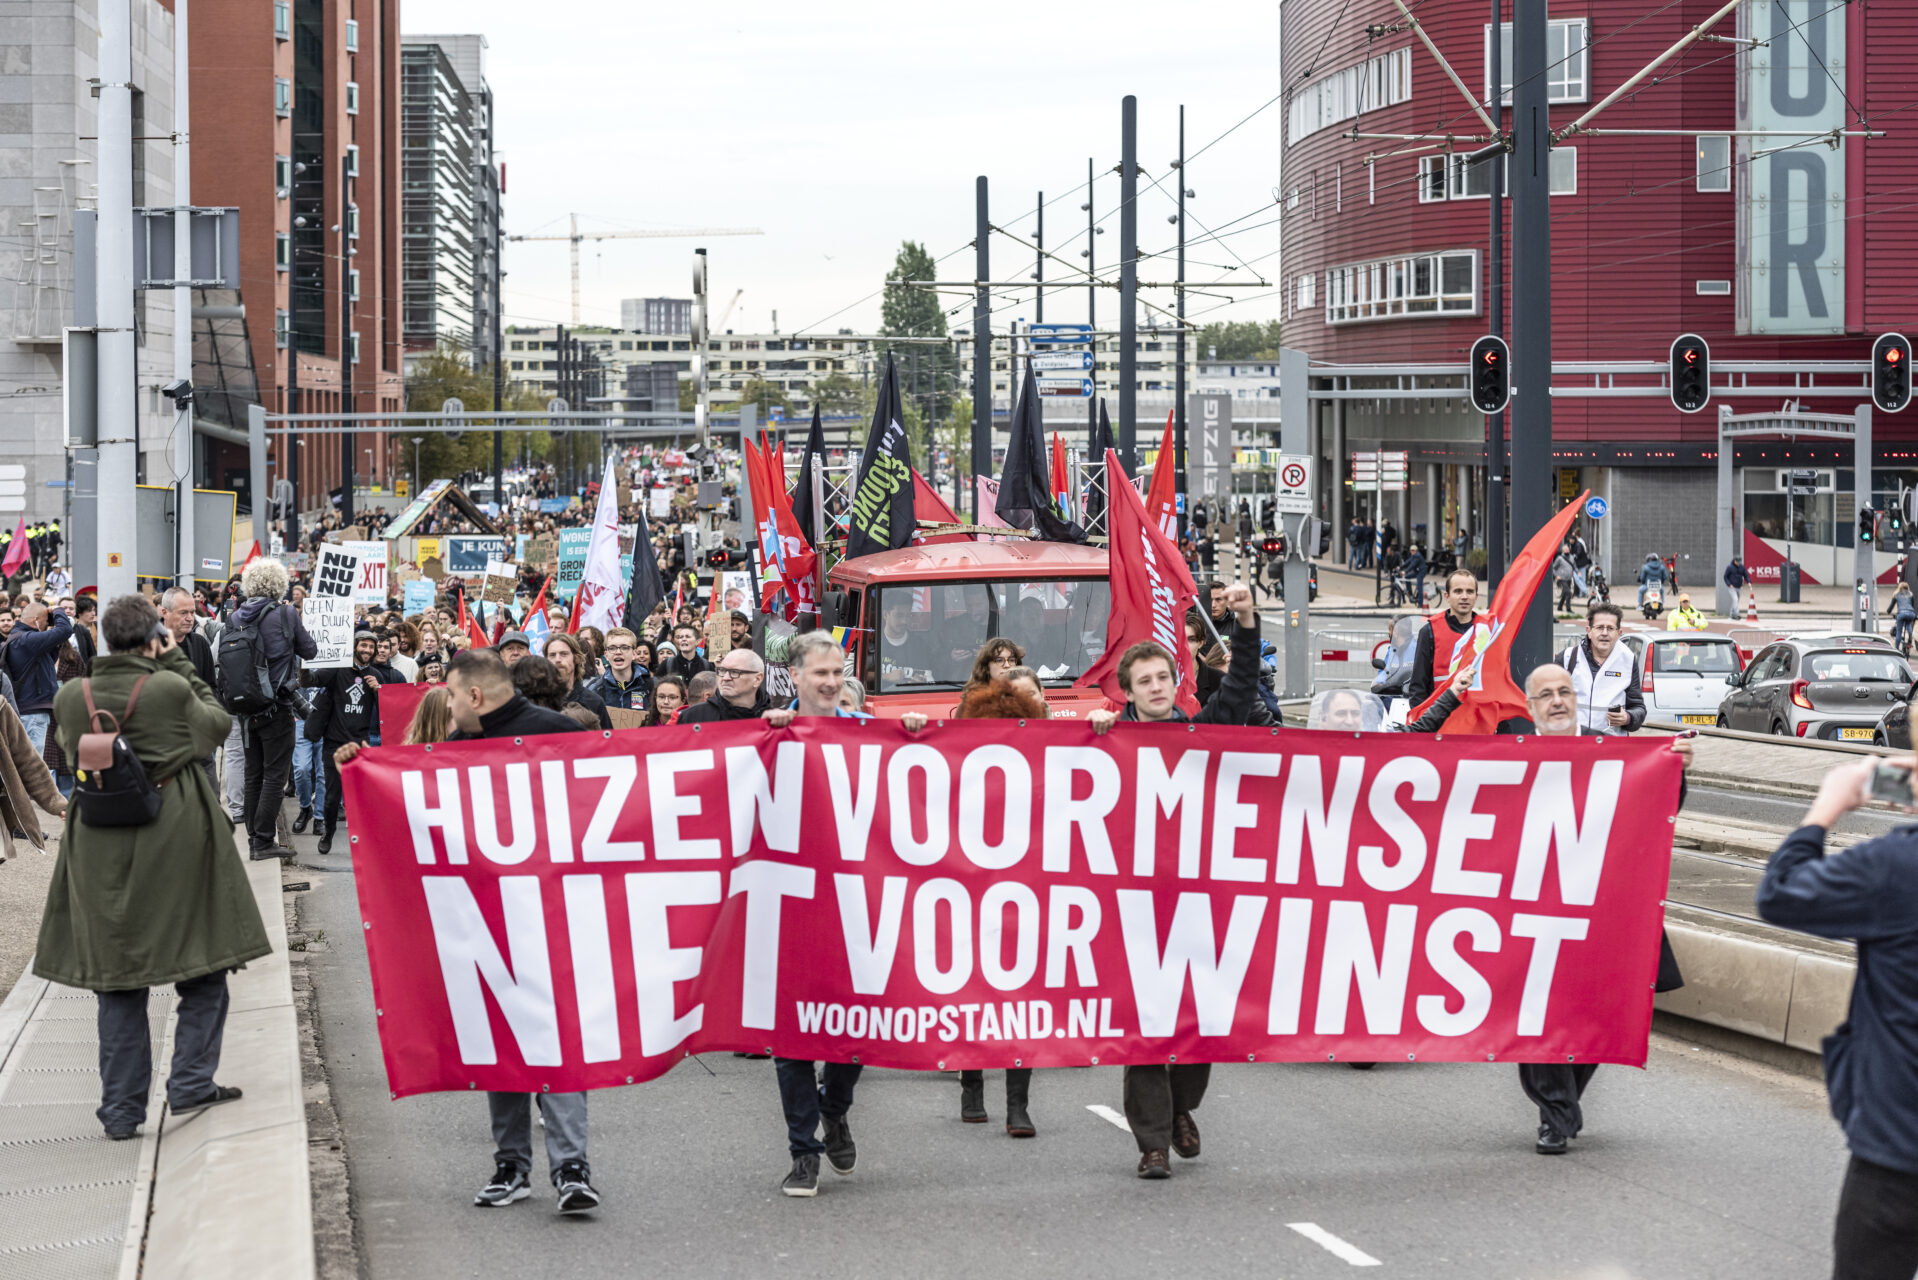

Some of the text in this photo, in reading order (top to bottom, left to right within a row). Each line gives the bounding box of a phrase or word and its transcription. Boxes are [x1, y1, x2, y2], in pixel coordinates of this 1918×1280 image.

[460, 541, 504, 553] JE KUN
[323, 551, 357, 569] NU
[320, 565, 354, 583] NU
[358, 562, 386, 589] XIT
[318, 579, 351, 597] NU
[304, 599, 334, 615] GEEN
[321, 615, 351, 628] DUUR
[344, 704, 363, 714] BPW
[401, 741, 1625, 906] HUIZEN VOOR MENSEN
[421, 859, 1590, 1067] NIET VOOR WINST
[796, 998, 1125, 1043] WOONOPSTAND.NL
